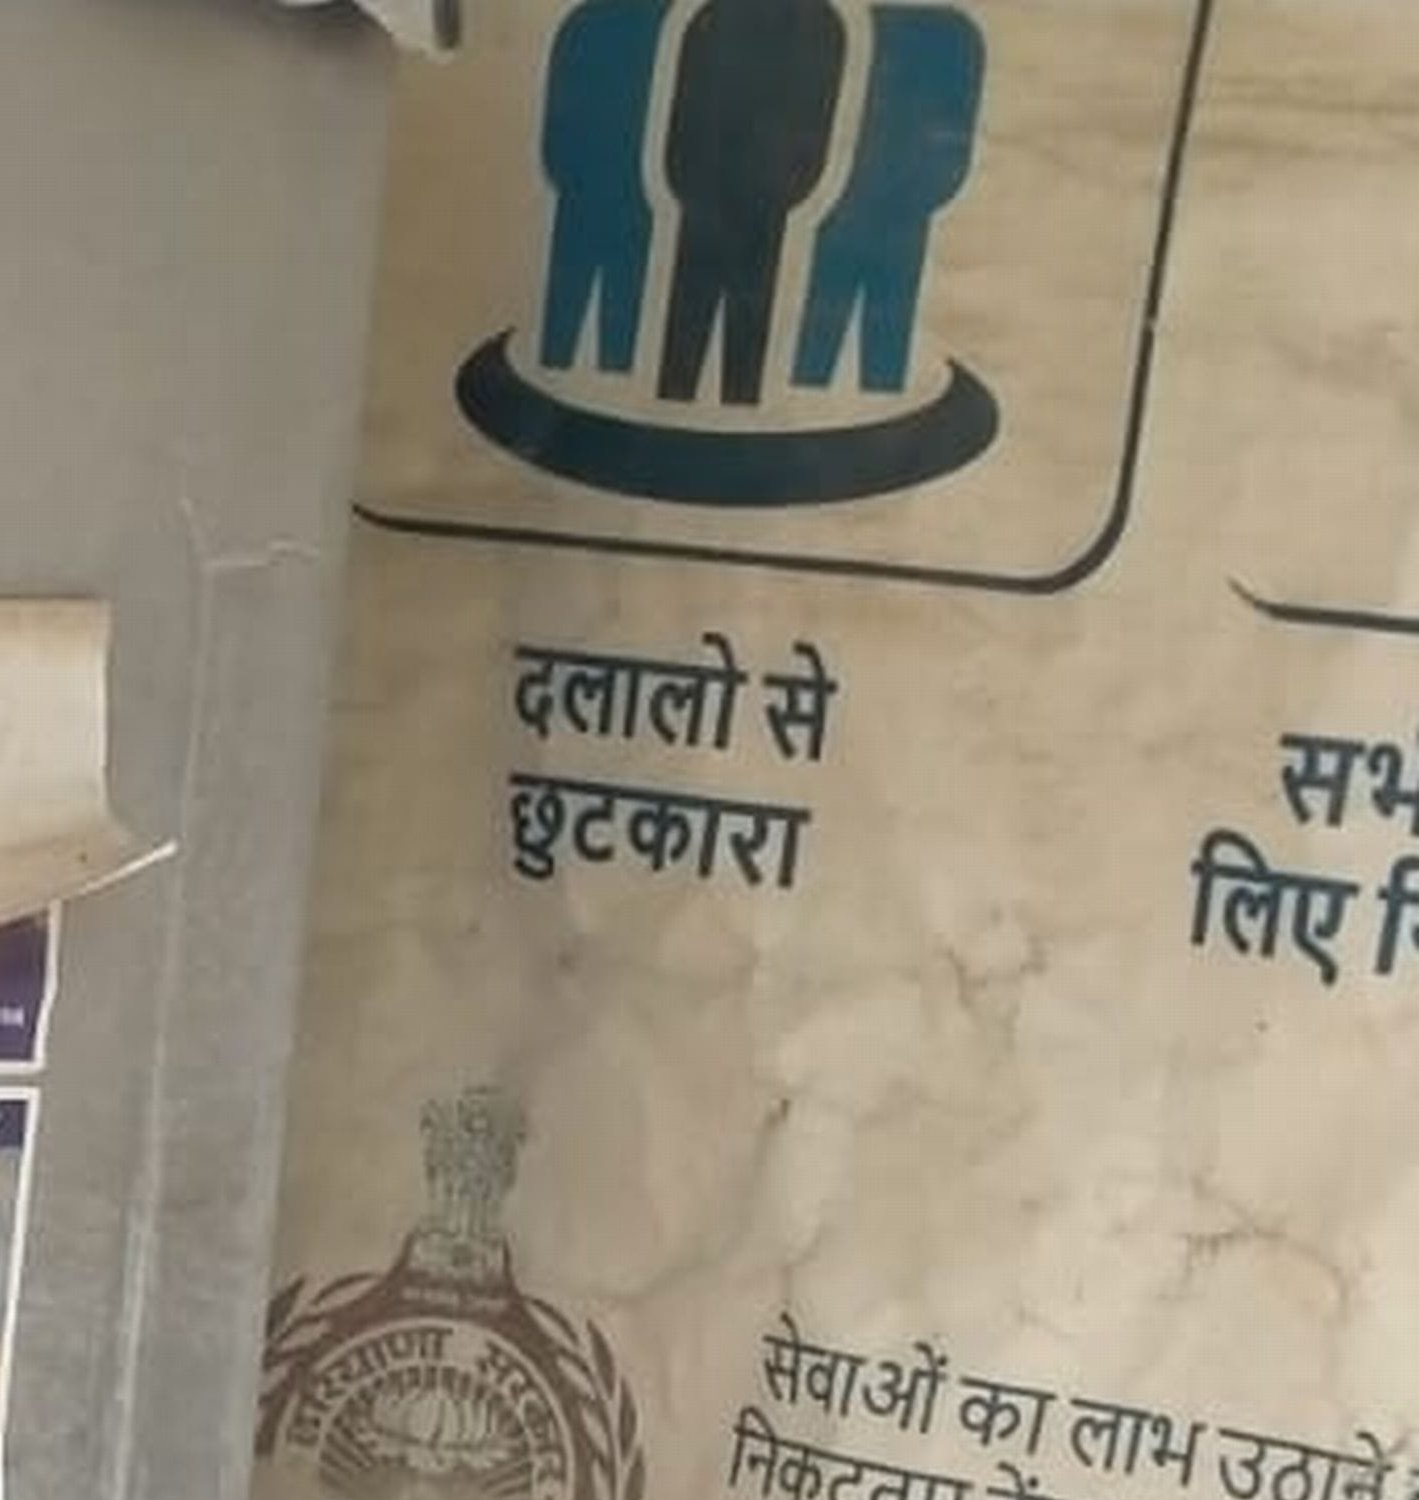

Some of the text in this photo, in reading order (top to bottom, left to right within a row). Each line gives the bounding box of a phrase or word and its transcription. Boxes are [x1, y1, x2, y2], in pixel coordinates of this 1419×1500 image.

[514, 633, 837, 761] दलालो से
[511, 770, 810, 889] छुटकारा
[1192, 828, 1360, 985] लिए
[764, 1313, 947, 1434] सेवाओं
[961, 1376, 1056, 1455] का
[1071, 1396, 1206, 1486] लाभ
